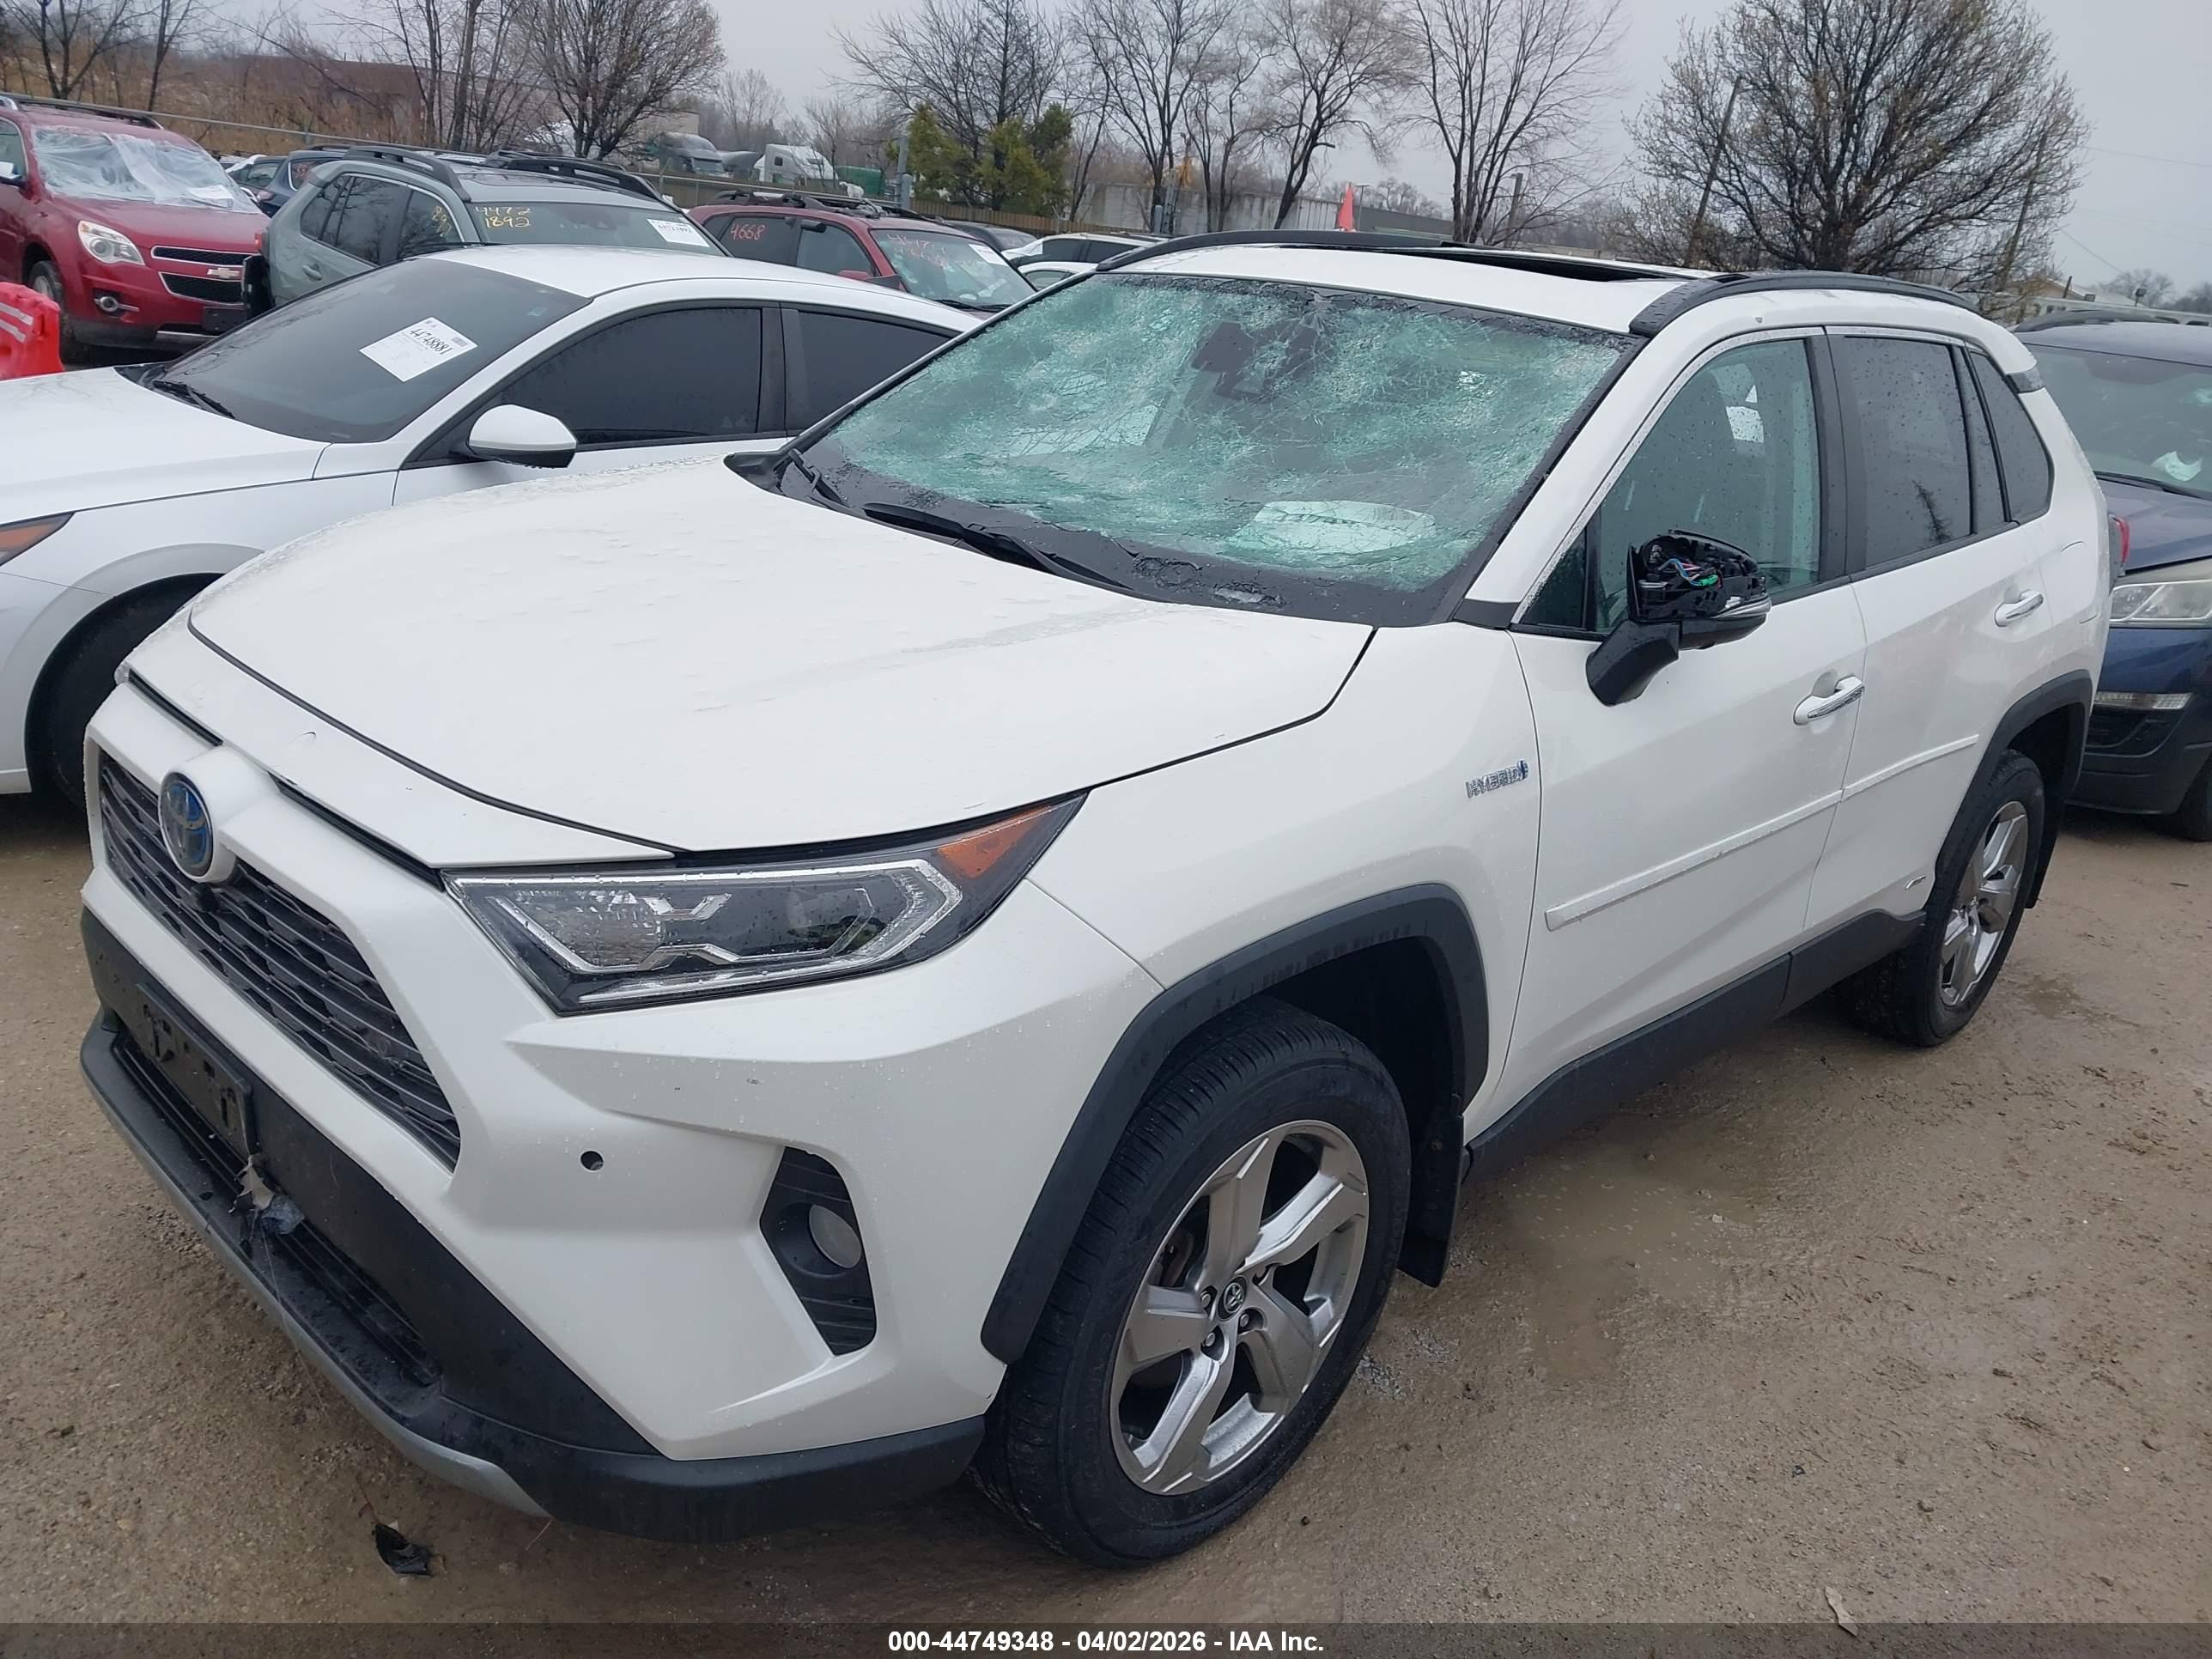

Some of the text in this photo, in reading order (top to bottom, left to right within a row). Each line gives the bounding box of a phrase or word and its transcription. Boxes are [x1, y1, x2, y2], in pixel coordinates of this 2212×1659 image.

[475, 205, 532, 216] 4472
[485, 216, 532, 228] 1892
[730, 223, 766, 240] 4668
[409, 328, 453, 355] 44748881
[1464, 765, 1522, 799] HYBRID
